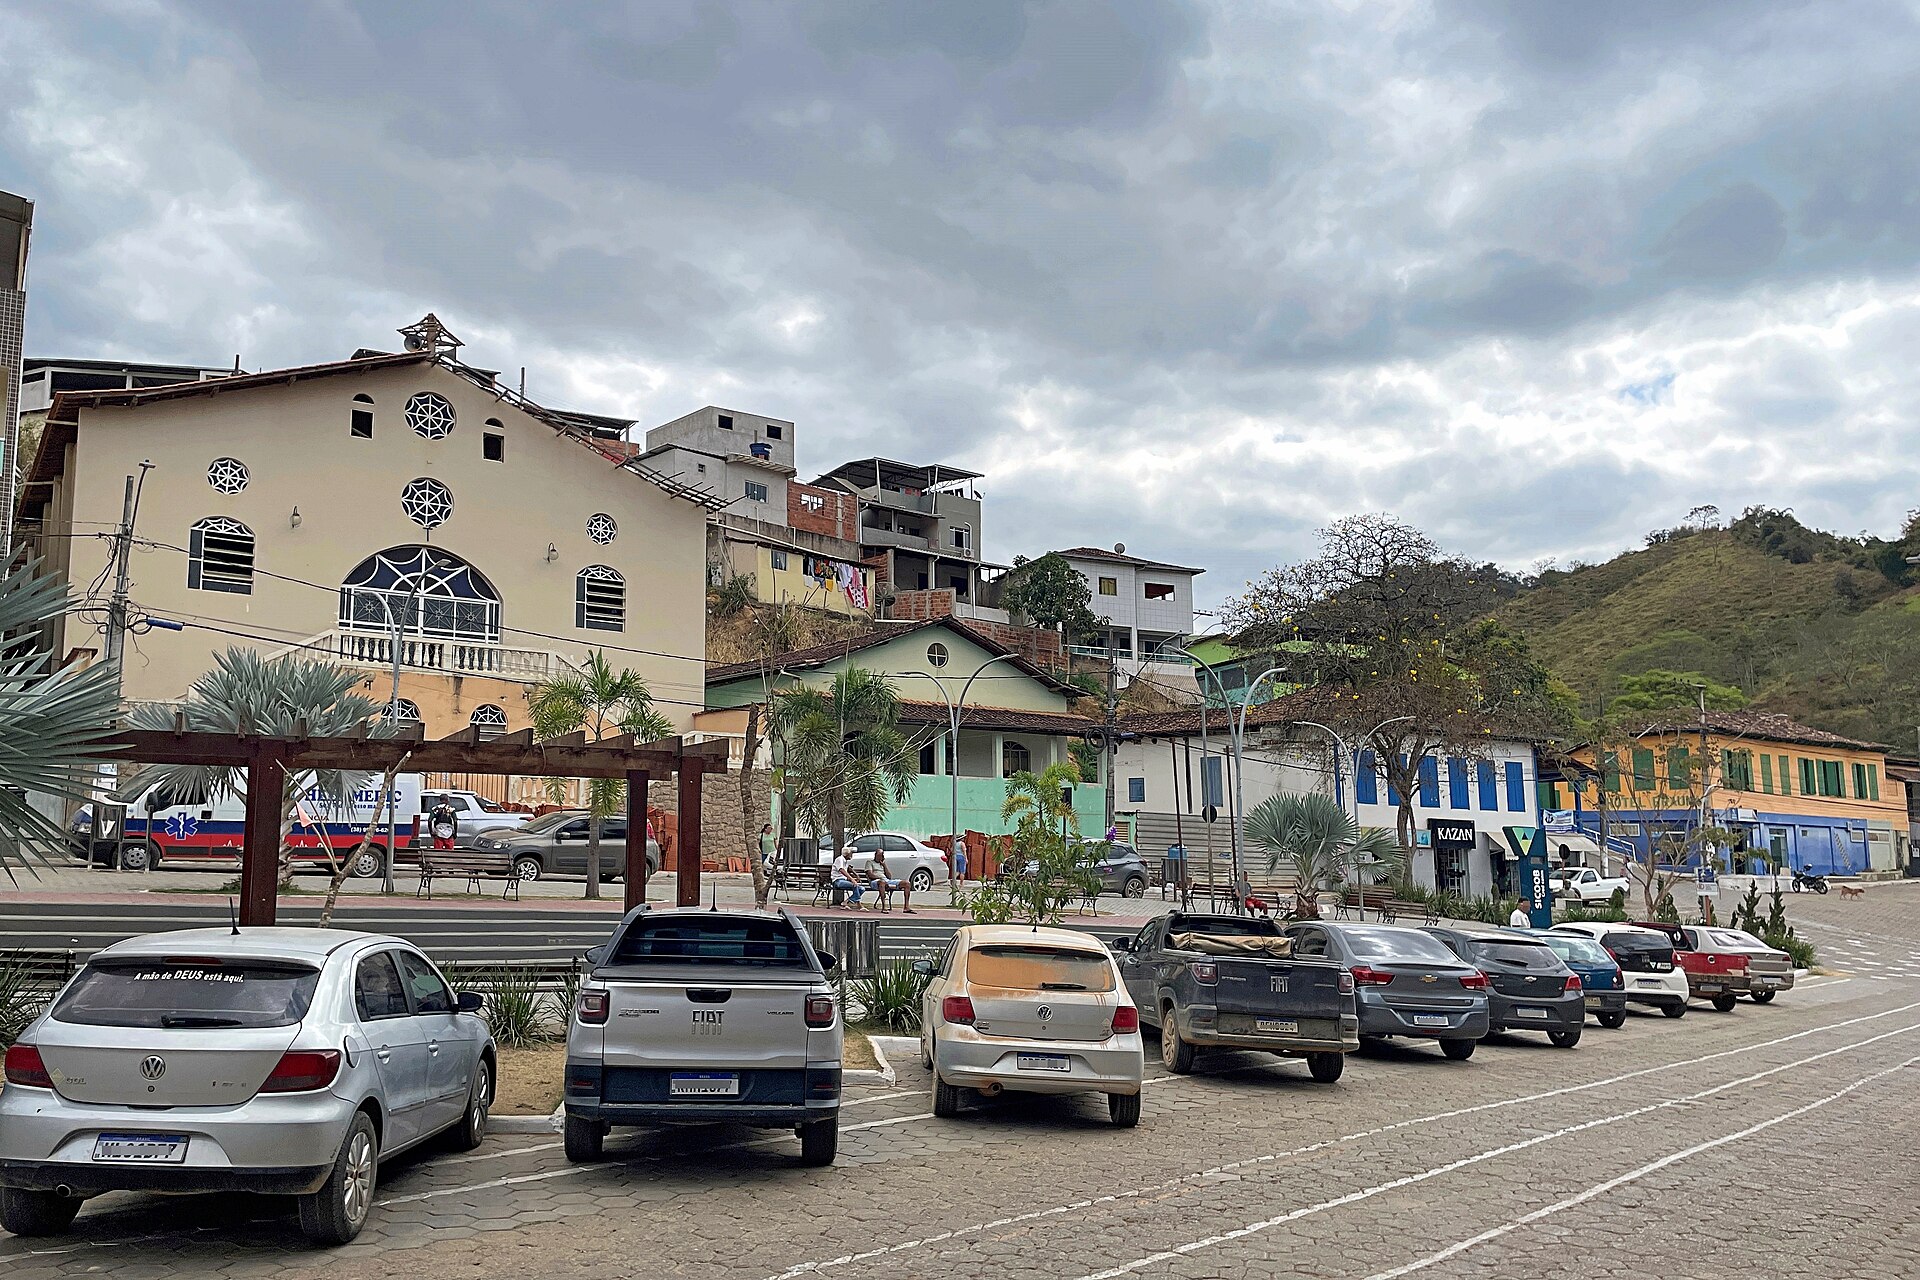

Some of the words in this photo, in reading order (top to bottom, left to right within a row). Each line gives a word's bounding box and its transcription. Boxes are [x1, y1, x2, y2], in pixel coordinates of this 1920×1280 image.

[1437, 827, 1473, 841] KAZAN
[1532, 869, 1543, 910] SICOOB
[134, 972, 142, 981] A
[142, 971, 160, 980] mão
[161, 972, 172, 980] de
[173, 970, 204, 980] DEUS
[203, 972, 223, 981] está
[223, 974, 244, 983] aqui.
[1270, 975, 1290, 993] FIAT
[691, 1009, 725, 1035] FIAT
